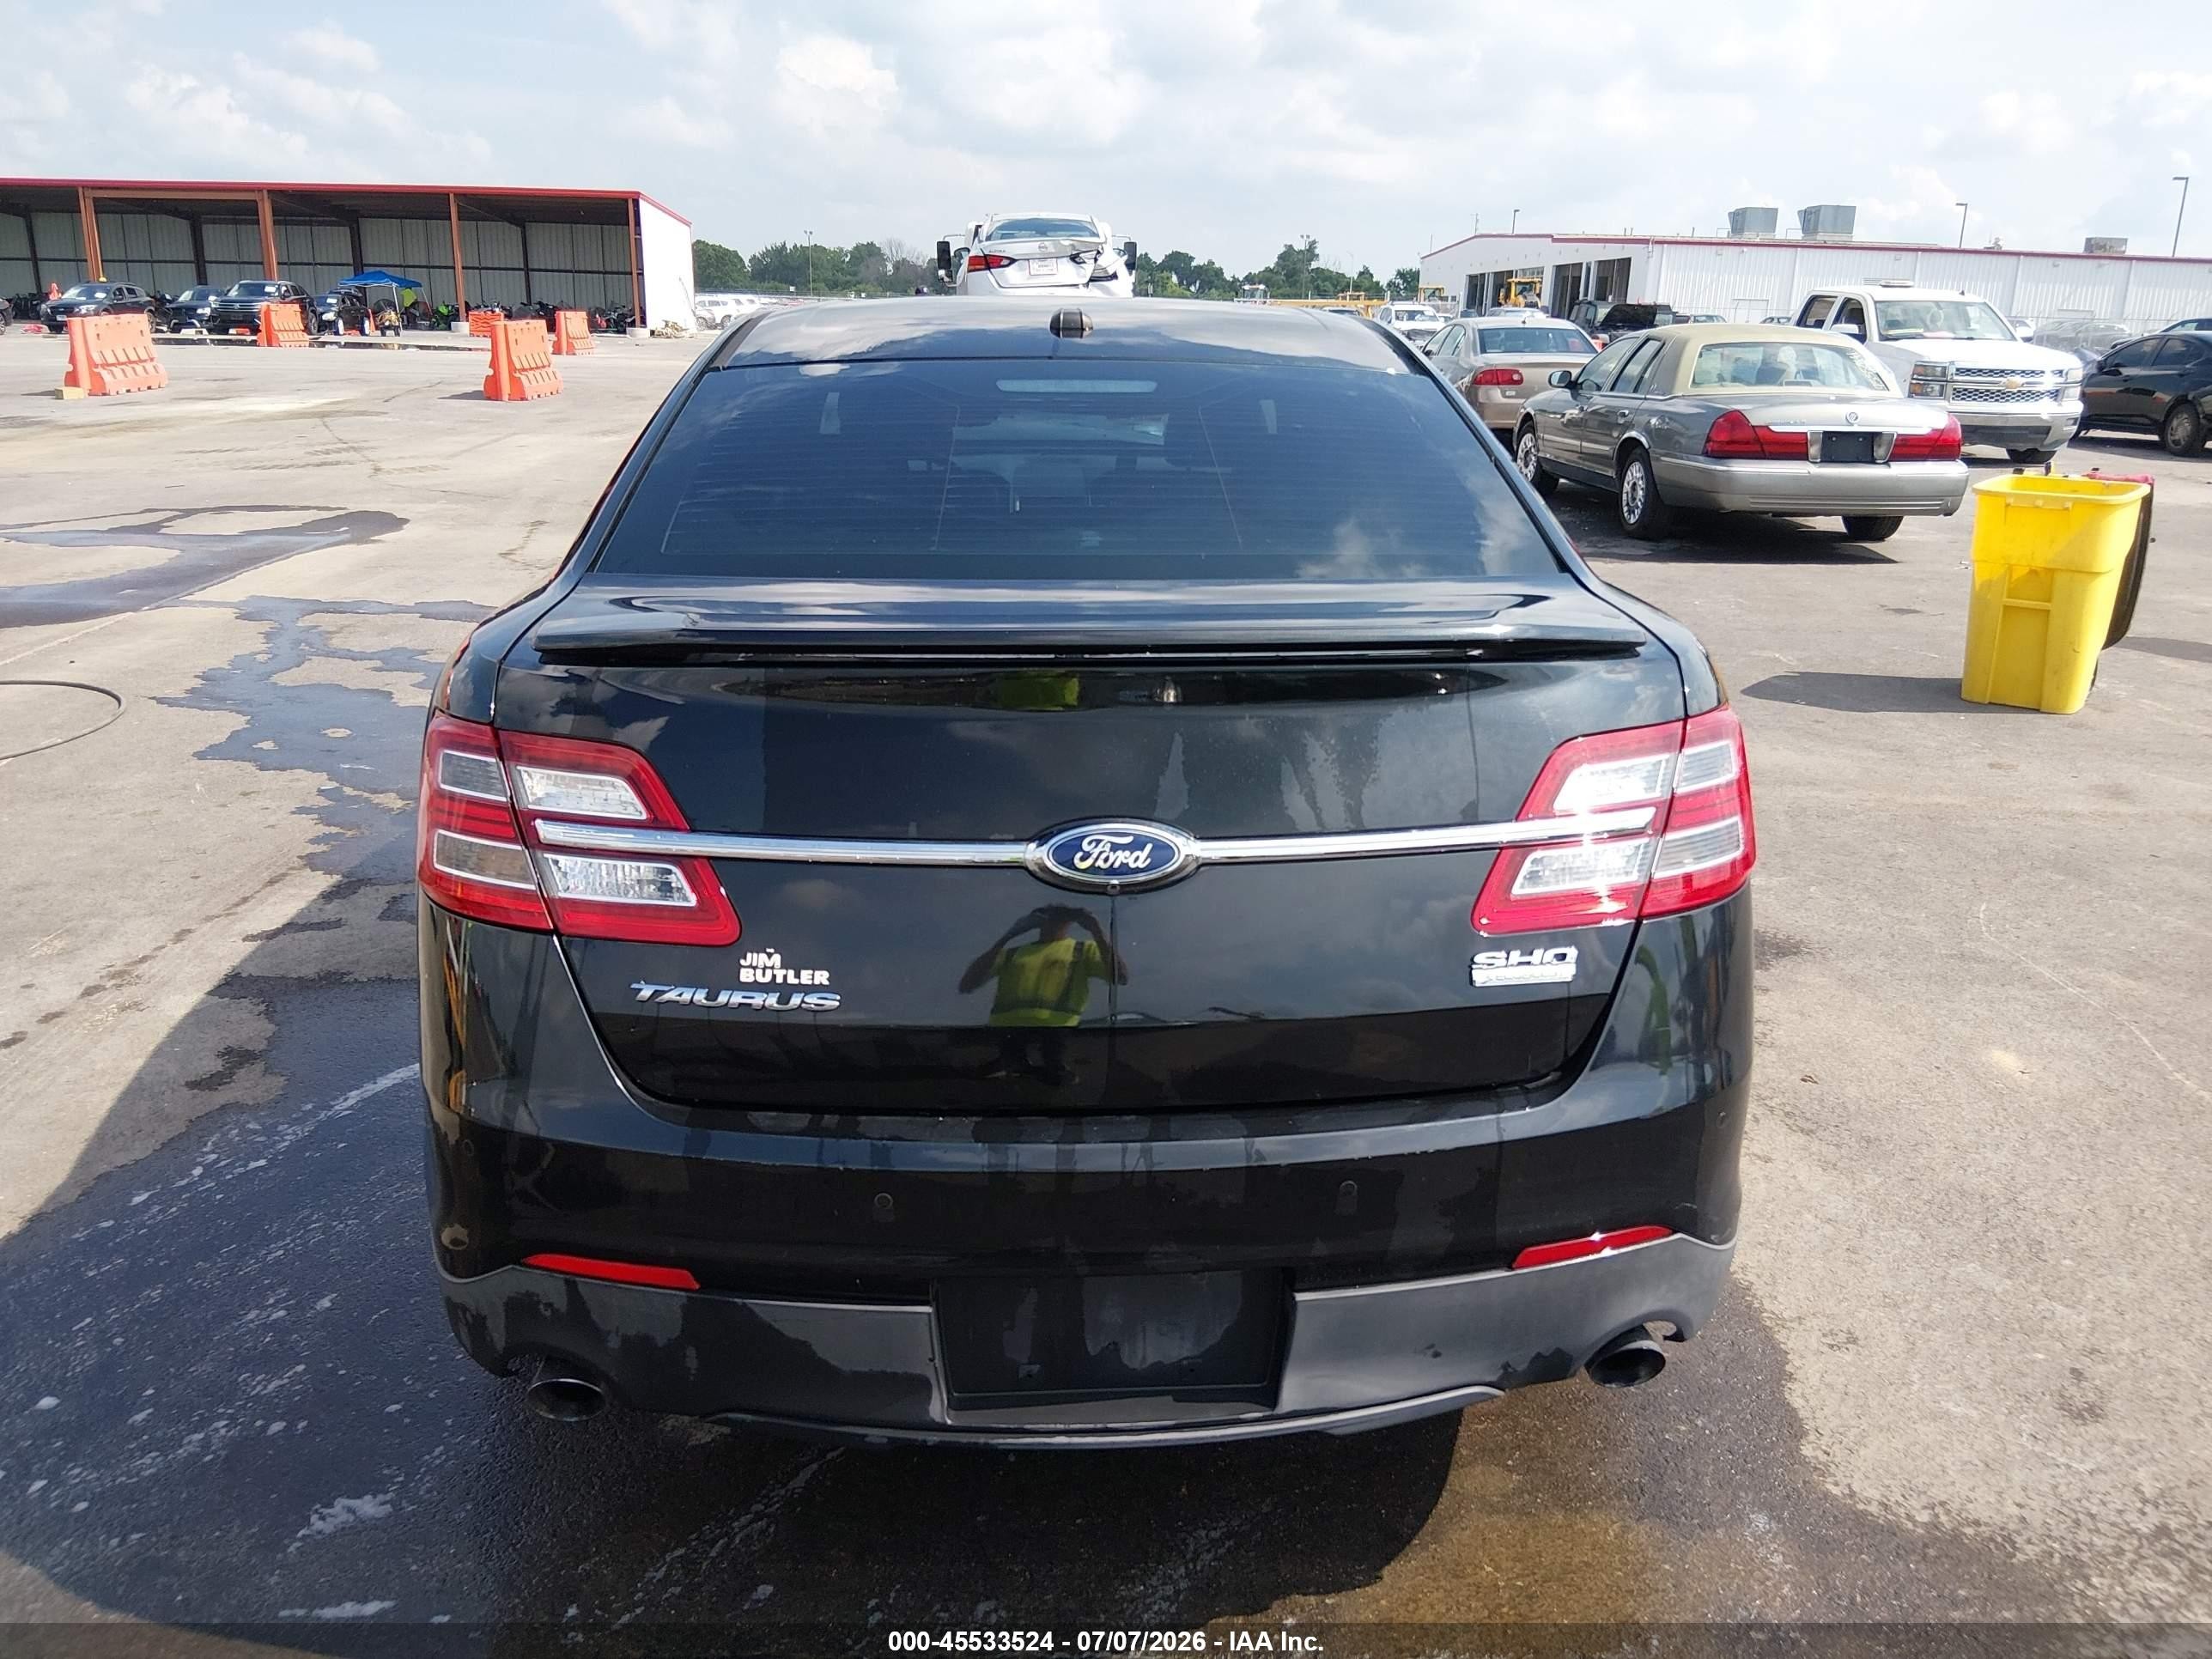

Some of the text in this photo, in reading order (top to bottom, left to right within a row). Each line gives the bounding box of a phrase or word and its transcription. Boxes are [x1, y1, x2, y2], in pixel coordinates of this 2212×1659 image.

[1073, 834, 1153, 870] Ford
[739, 951, 781, 969] JIM
[1471, 945, 1579, 969] SHO
[739, 968, 831, 986] BUTLER
[629, 981, 842, 1012] TAURUS
